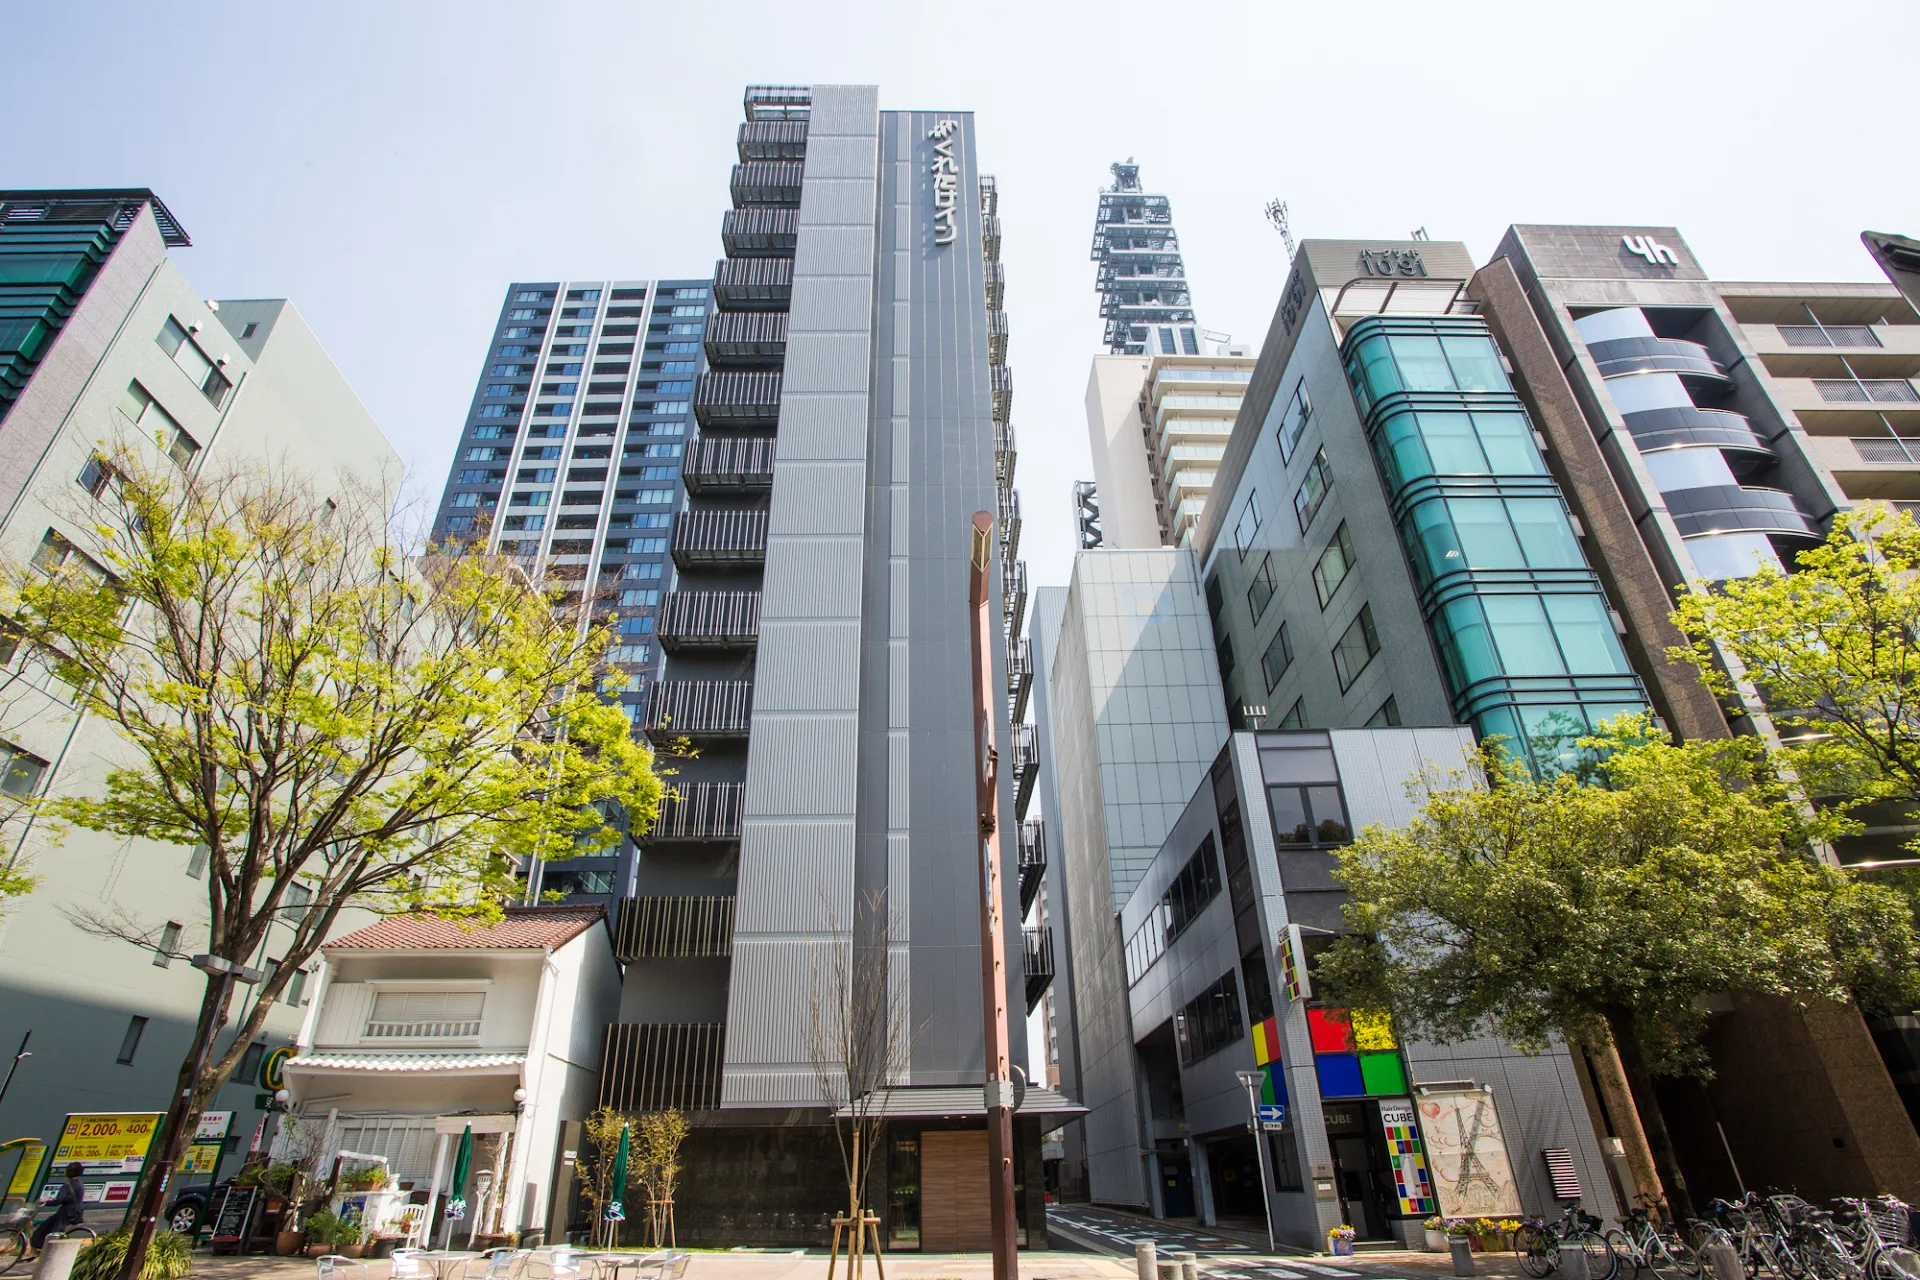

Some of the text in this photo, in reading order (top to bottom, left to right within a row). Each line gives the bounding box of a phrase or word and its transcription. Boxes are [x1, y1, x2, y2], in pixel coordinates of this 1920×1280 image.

[931, 139, 958, 245] くれたけイン
[1361, 248, 1419, 258] パークサイド
[1362, 258, 1427, 276] 1091
[1324, 1114, 1352, 1124] CUBE
[1384, 1113, 1414, 1122] CUBE
